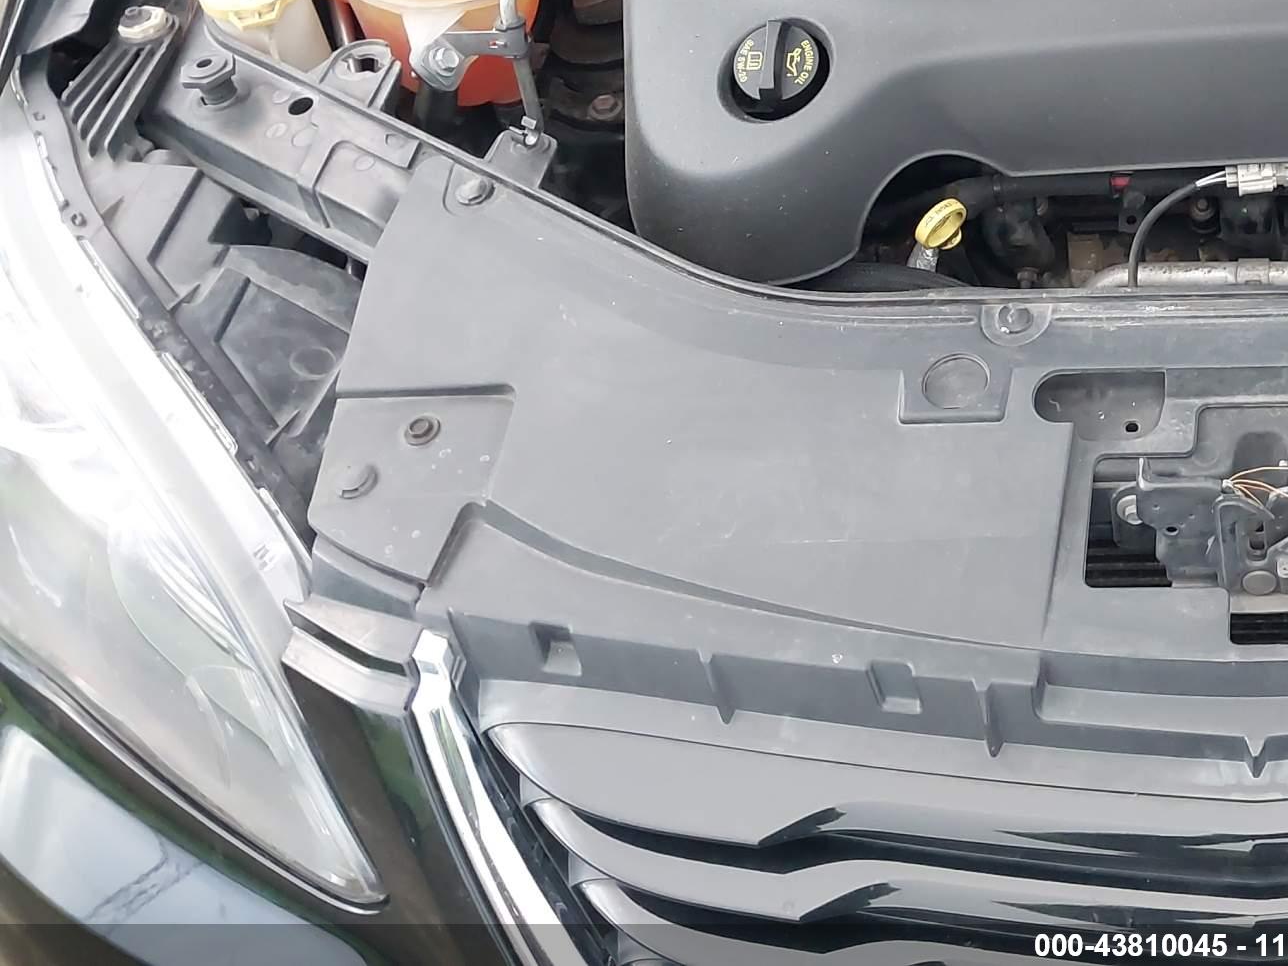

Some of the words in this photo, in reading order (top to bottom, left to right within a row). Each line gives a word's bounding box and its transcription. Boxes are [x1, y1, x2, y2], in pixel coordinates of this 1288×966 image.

[740, 39, 754, 56] SAE
[801, 39, 814, 71] ENGINE
[794, 71, 809, 85] OIL
